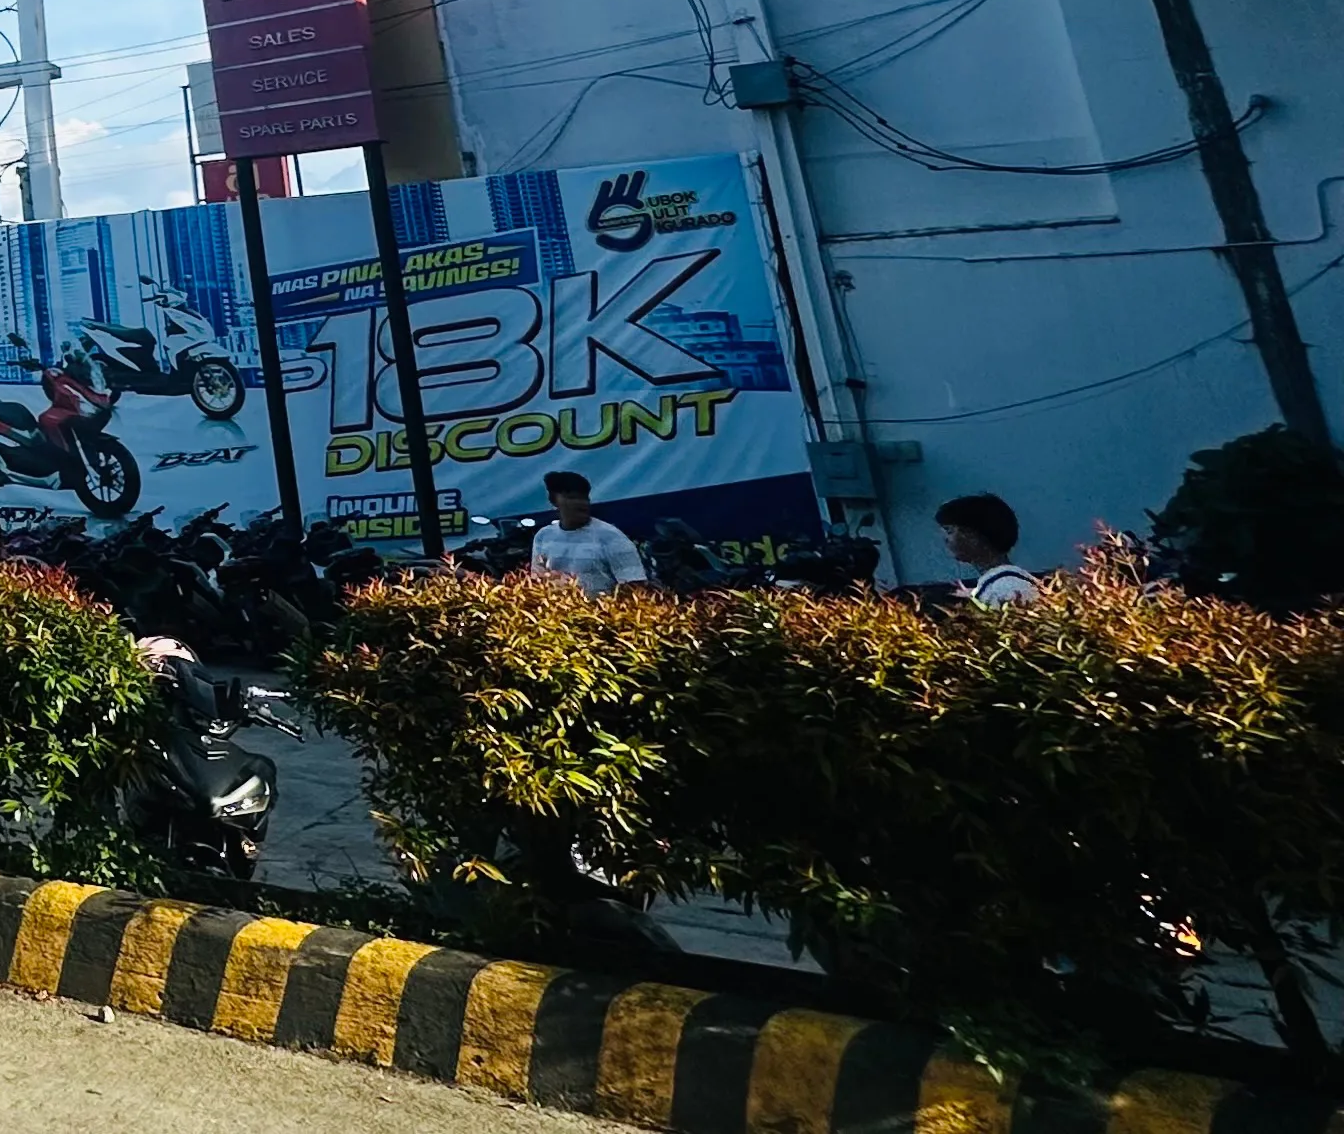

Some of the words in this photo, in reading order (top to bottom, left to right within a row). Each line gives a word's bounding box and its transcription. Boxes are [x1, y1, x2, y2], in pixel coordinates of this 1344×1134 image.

[249, 27, 316, 50] SALES
[252, 69, 329, 93] SERVICE
[239, 121, 295, 139] SPARE
[300, 113, 358, 131] PARTS
[272, 275, 318, 296] MAS
[321, 242, 485, 290] PINAAKAS
[344, 286, 375, 302] NA
[324, 386, 739, 479] DISCOUNT
[330, 492, 457, 519] INQUIE
